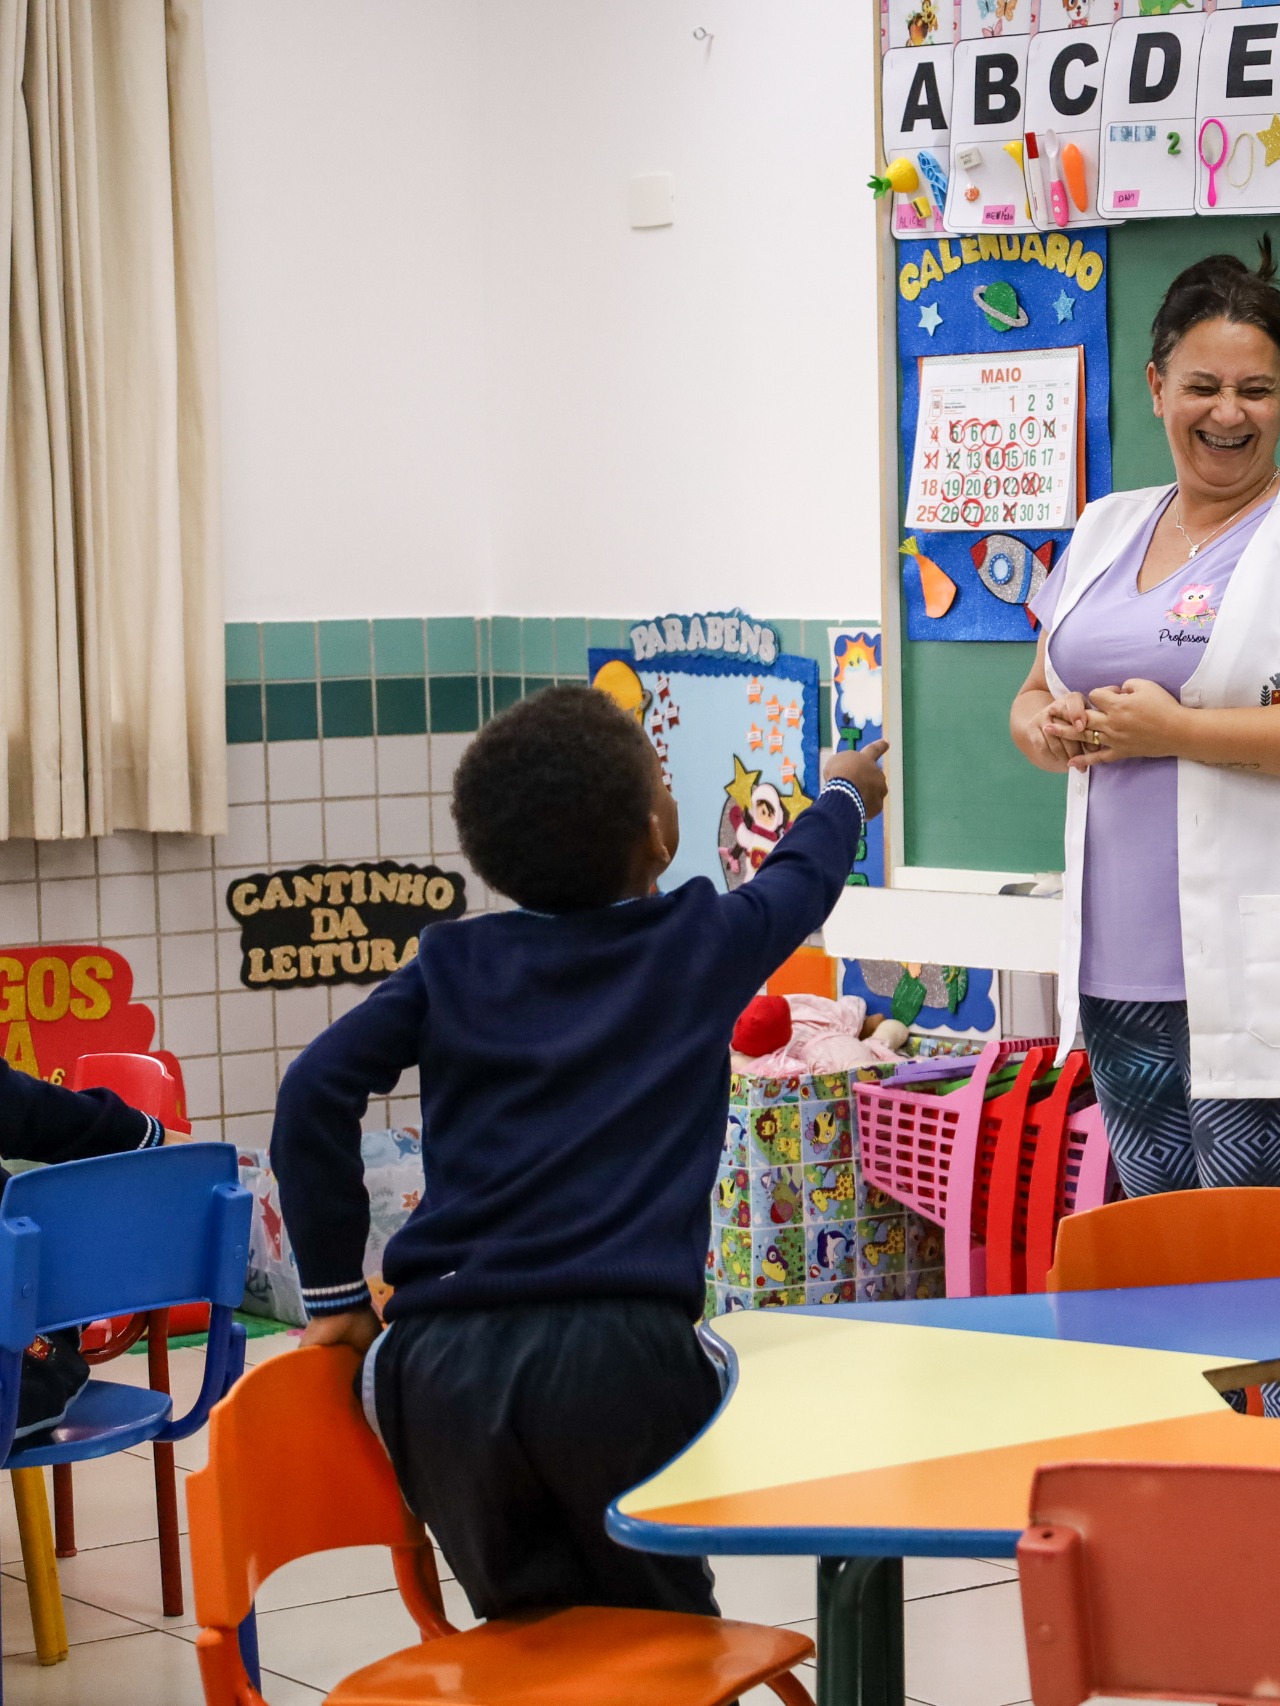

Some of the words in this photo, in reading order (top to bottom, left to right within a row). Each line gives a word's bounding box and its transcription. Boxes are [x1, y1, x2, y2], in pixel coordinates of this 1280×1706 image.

[1049, 42, 1099, 116] C
[1129, 31, 1182, 104] D
[1225, 22, 1278, 98] E
[900, 61, 949, 133] A
[974, 53, 1021, 125] B
[981, 367, 1022, 383] MAIO
[1009, 395, 1015, 413] 1
[1028, 394, 1036, 412] 2
[1046, 393, 1053, 411] 3
[971, 425, 978, 441] 6
[990, 424, 997, 441] 7
[1009, 423, 1016, 440] 8
[1028, 422, 1035, 439] 9
[946, 451, 960, 469] 12
[967, 451, 981, 469] 13
[1005, 450, 1018, 467] 15
[1023, 449, 1036, 467] 16
[1042, 448, 1053, 466] 17
[921, 478, 938, 496] 18
[945, 479, 960, 496] 19
[966, 478, 981, 496] 20
[1039, 476, 1052, 493] 24
[916, 504, 937, 523] 25
[941, 505, 959, 523] 26
[963, 506, 980, 523] 27
[984, 505, 999, 522] 28
[1020, 503, 1034, 520] 30
[1037, 502, 1050, 520] 31
[630, 607, 776, 662] PARABÉNS
[232, 870, 455, 917] CANTINHO
[311, 906, 369, 941] DA
